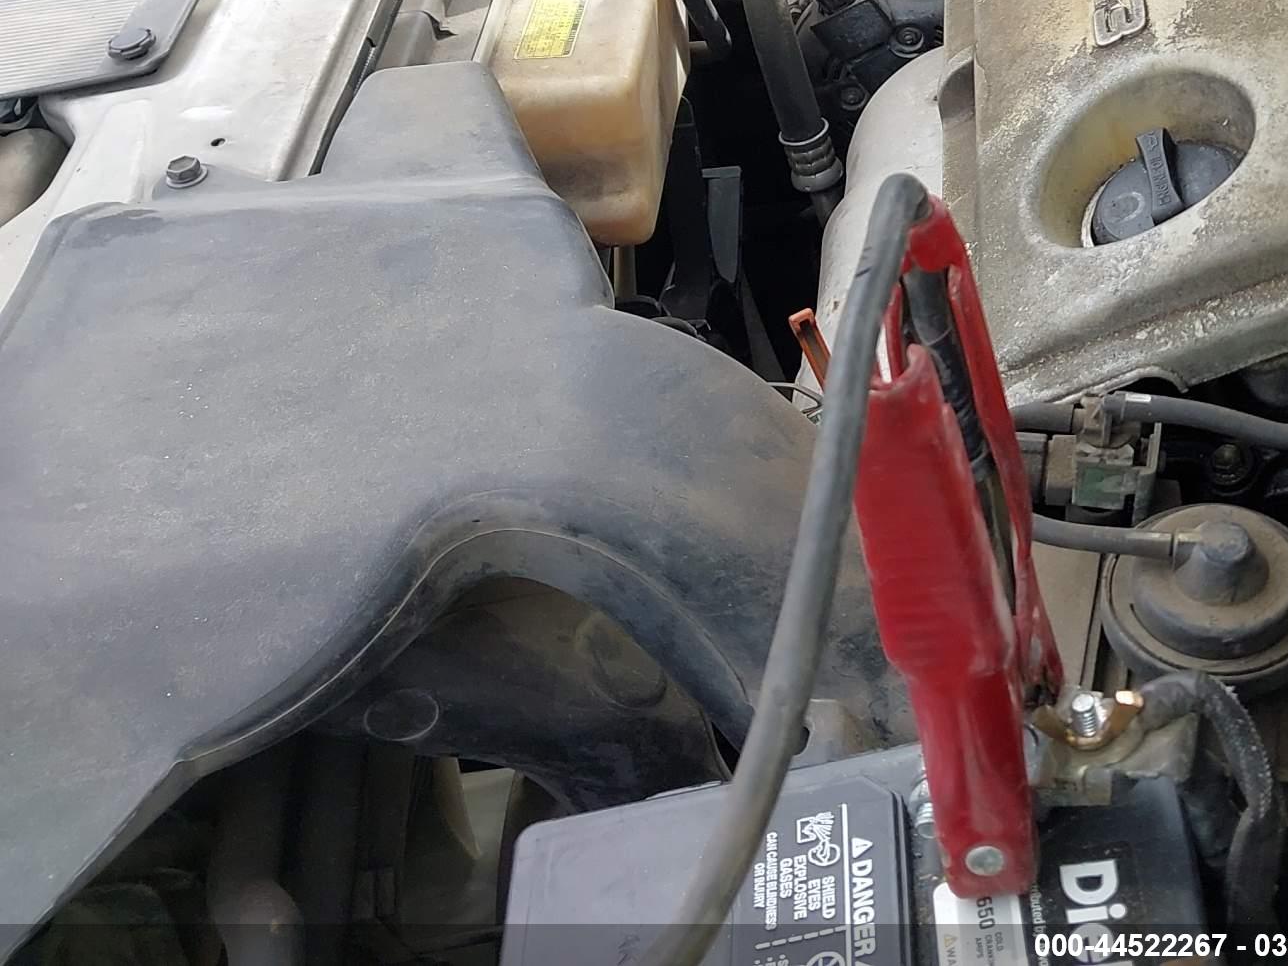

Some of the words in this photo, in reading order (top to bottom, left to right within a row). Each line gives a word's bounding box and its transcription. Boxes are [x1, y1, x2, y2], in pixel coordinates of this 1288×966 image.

[766, 832, 778, 851] CAN
[753, 863, 765, 876] OR
[766, 851, 778, 881] CAUSE
[779, 857, 793, 899] GASES
[753, 876, 765, 908] INJURY
[793, 854, 808, 920] EXPLOSIVE
[807, 878, 822, 911] EYES
[822, 875, 836, 919] SHIELD
[764, 881, 778, 931] BLINDNESS
[851, 858, 876, 957] DANGER
[976, 896, 996, 930] 650
[994, 931, 1004, 952] COLD
